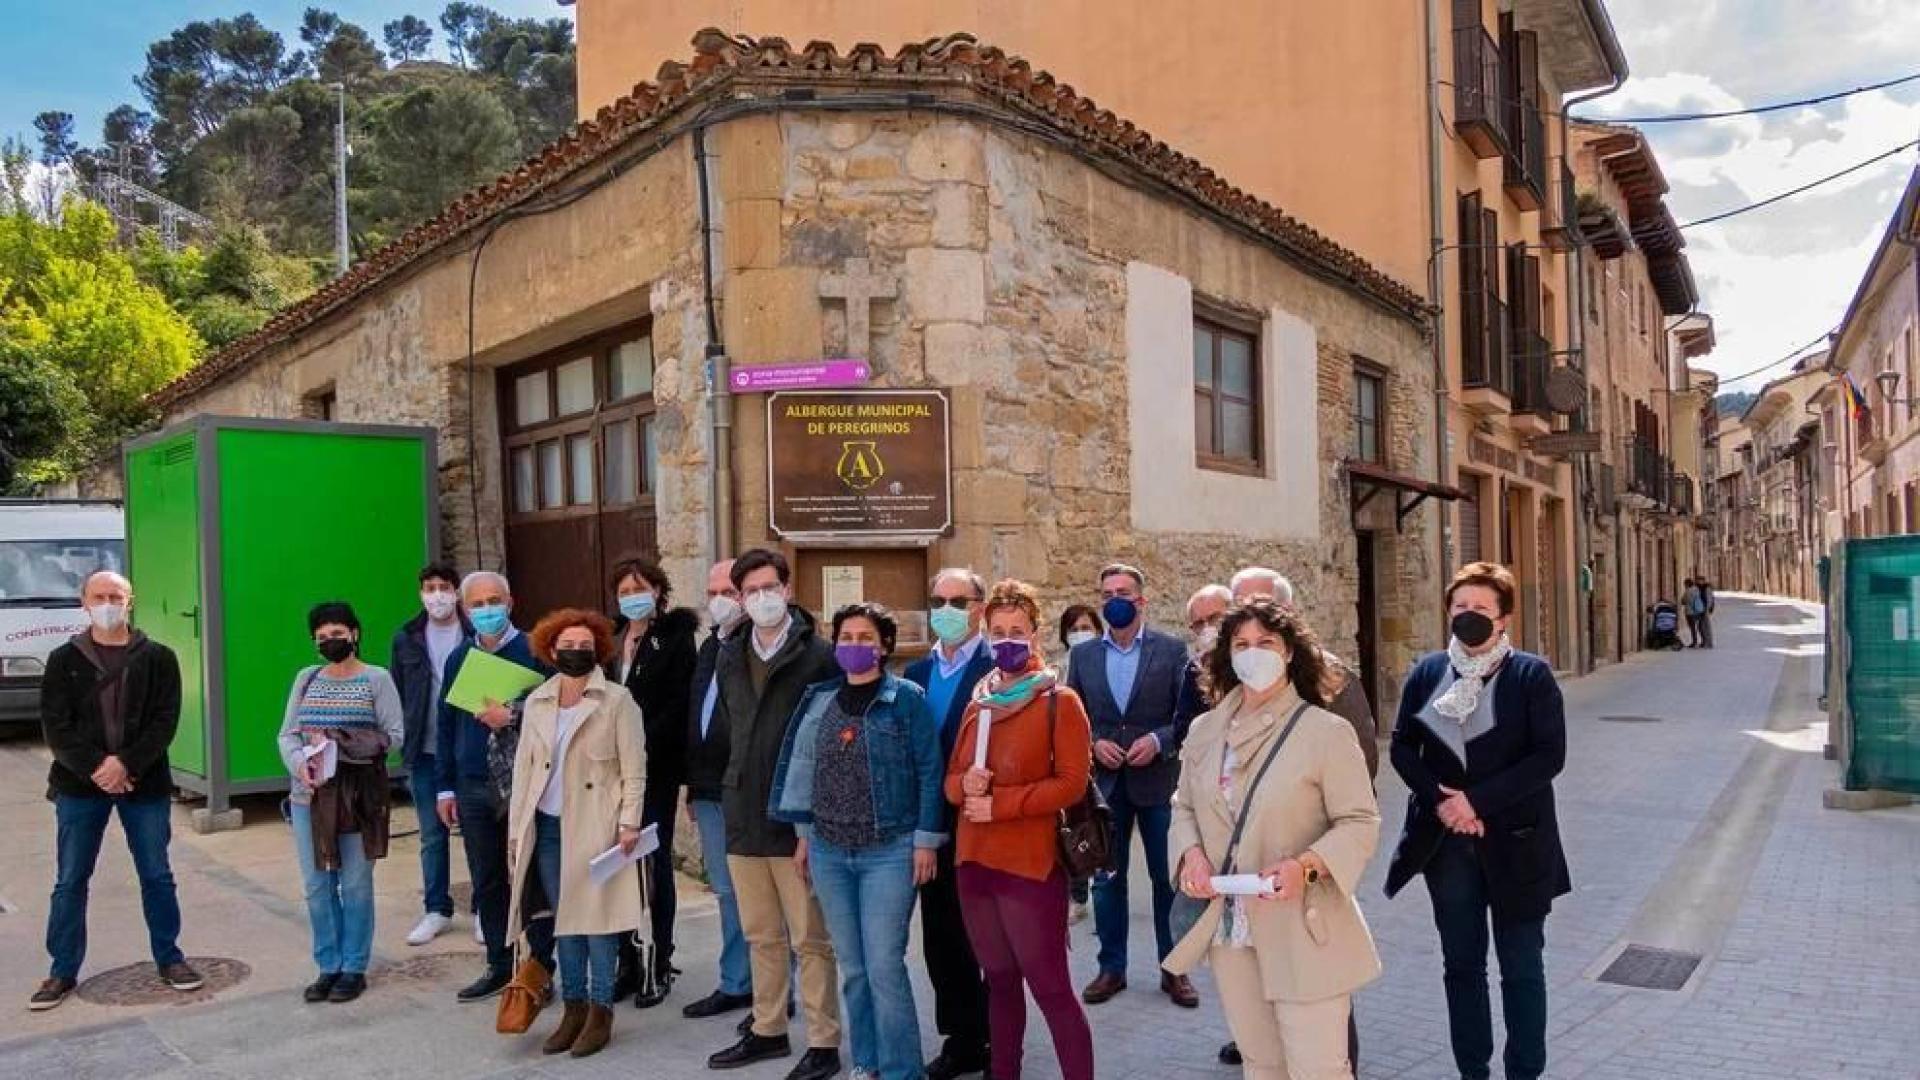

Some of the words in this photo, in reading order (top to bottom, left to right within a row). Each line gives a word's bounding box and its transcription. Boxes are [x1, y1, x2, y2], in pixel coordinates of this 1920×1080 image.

[786, 404, 855, 418] ALBERGUE
[857, 403, 931, 417] MUNICIPAL
[808, 421, 826, 435] DE
[828, 421, 911, 434] PEREGRINOS
